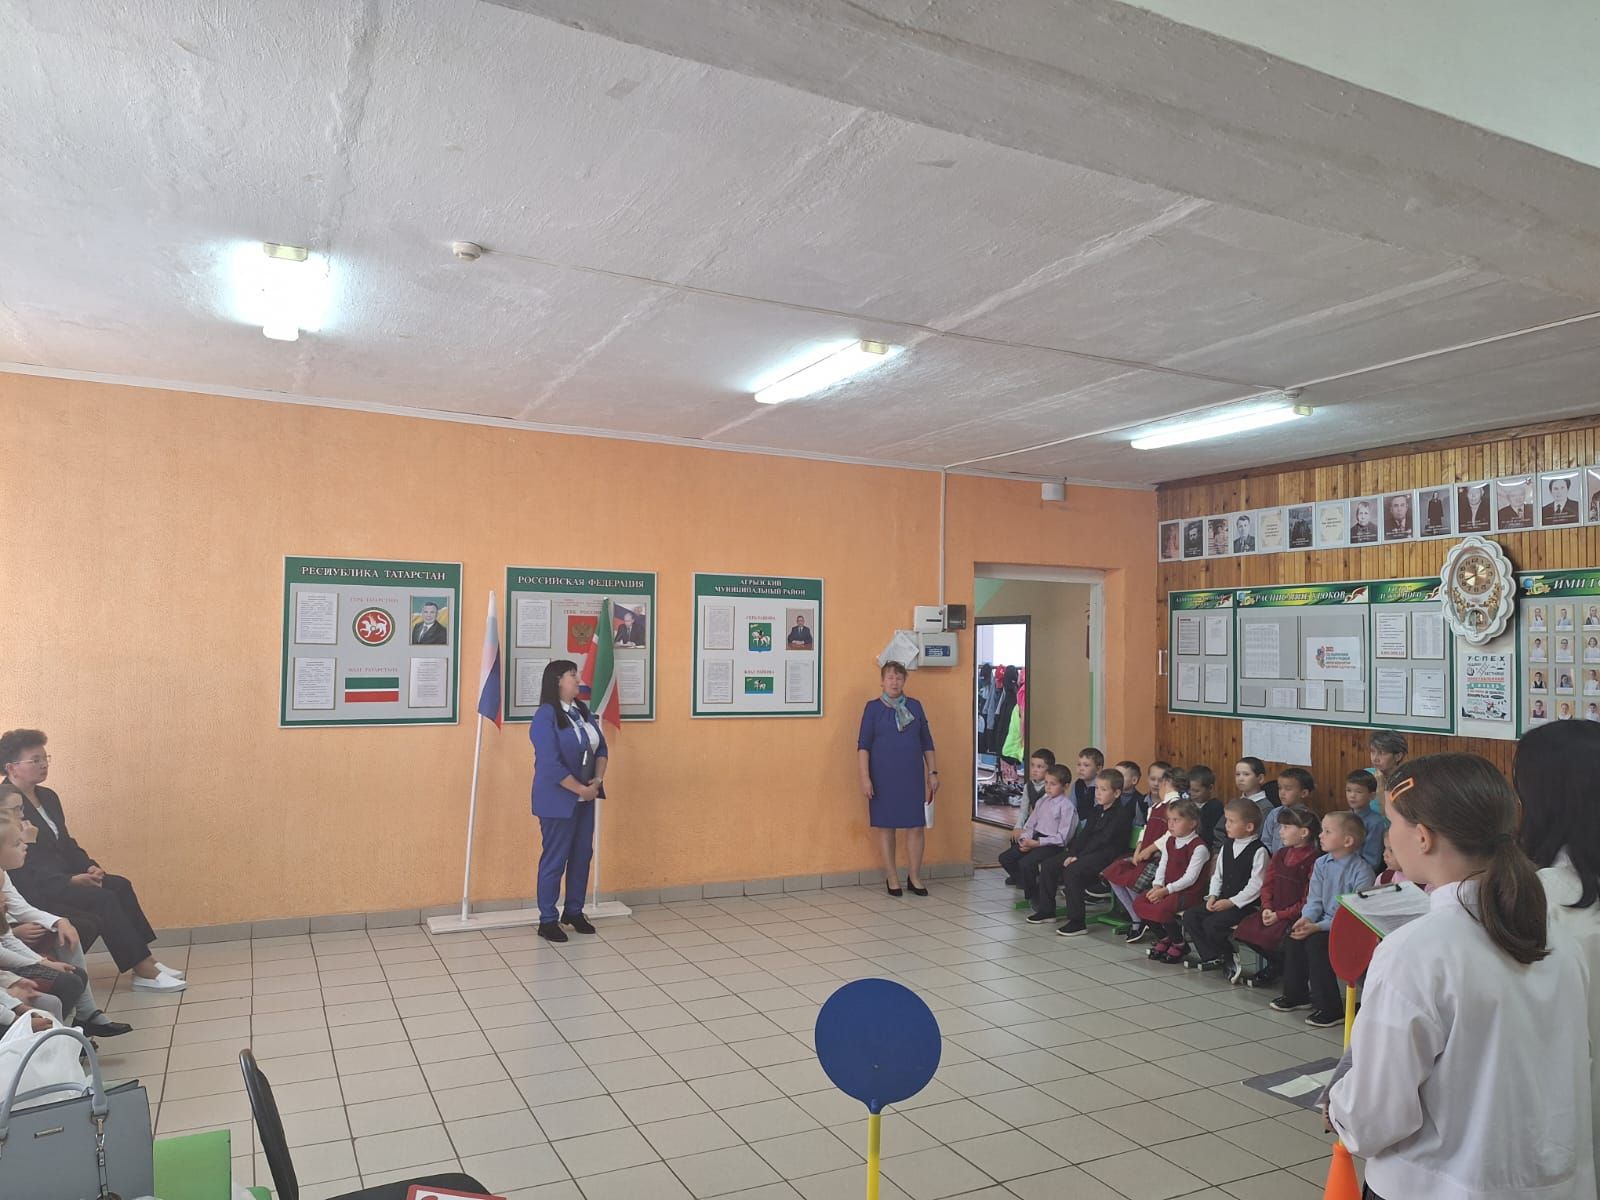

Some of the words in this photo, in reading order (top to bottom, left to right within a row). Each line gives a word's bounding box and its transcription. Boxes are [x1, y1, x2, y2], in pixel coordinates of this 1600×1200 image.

[301, 566, 379, 578] РЕСПУБЛИКА
[383, 569, 446, 581] ТАТАРСТАН
[517, 575, 585, 586] РОССИЙСКАЯ
[587, 578, 645, 588] ФЕДЕРАЦИЯ
[714, 585, 781, 594] МУНИЦИПАЛЬНЫЙ
